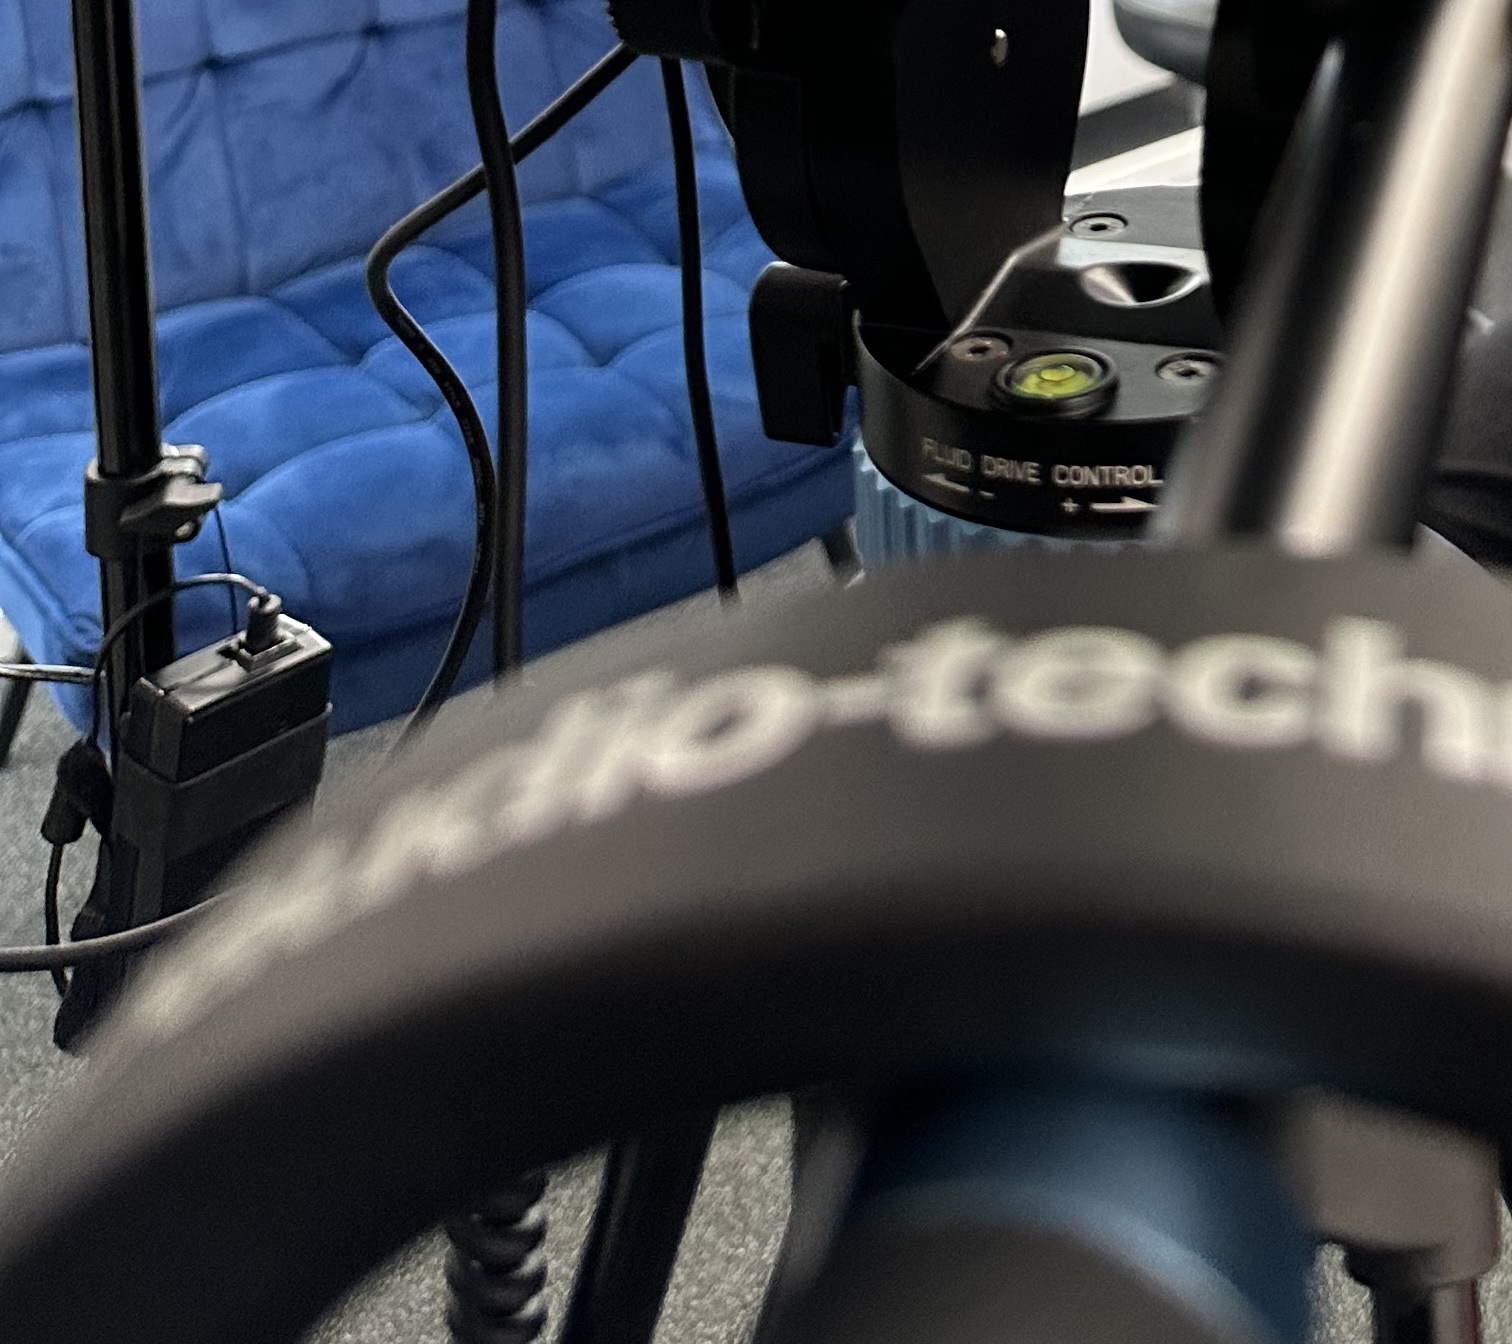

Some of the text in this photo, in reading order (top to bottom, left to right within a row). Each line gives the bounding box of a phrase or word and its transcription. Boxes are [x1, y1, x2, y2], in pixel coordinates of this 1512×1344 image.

[920, 437, 1164, 488] FLUID DRIVE CONTROL
